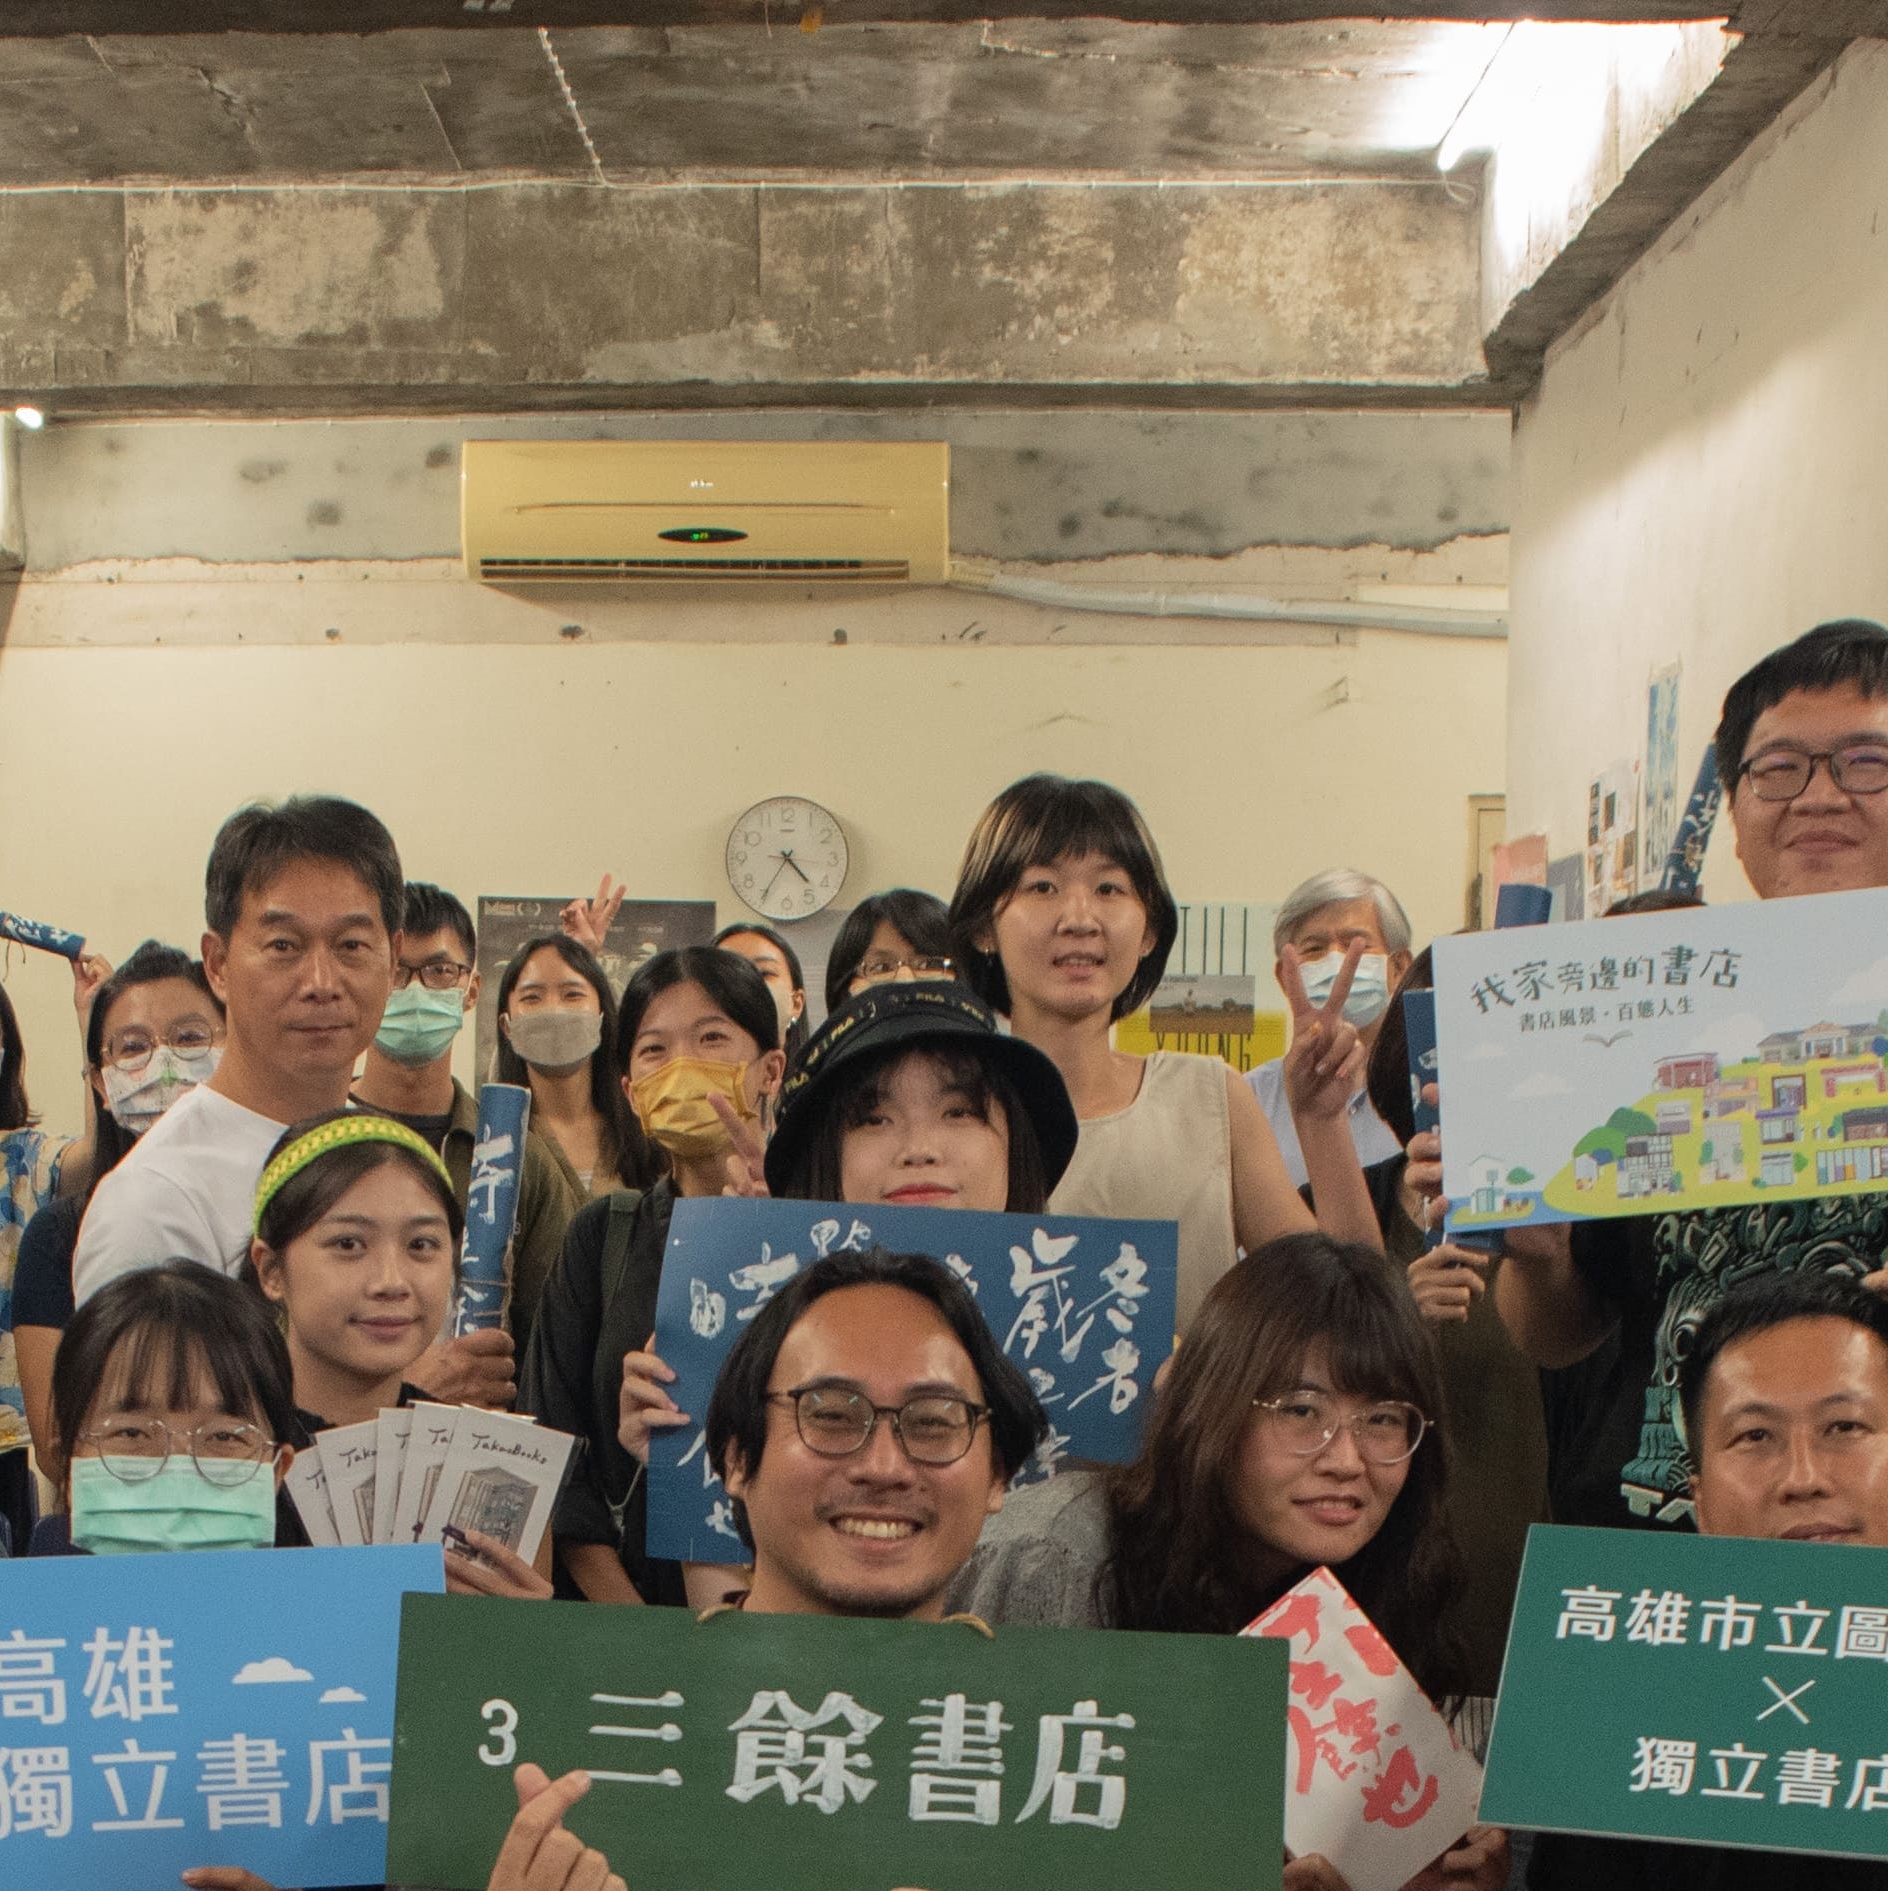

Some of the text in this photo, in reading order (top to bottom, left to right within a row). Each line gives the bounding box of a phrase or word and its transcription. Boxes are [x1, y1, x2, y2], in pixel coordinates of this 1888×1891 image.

[1471, 944, 1743, 1015] 我家旁邊的書店
[588, 1689, 1136, 1830] 三餘書店
